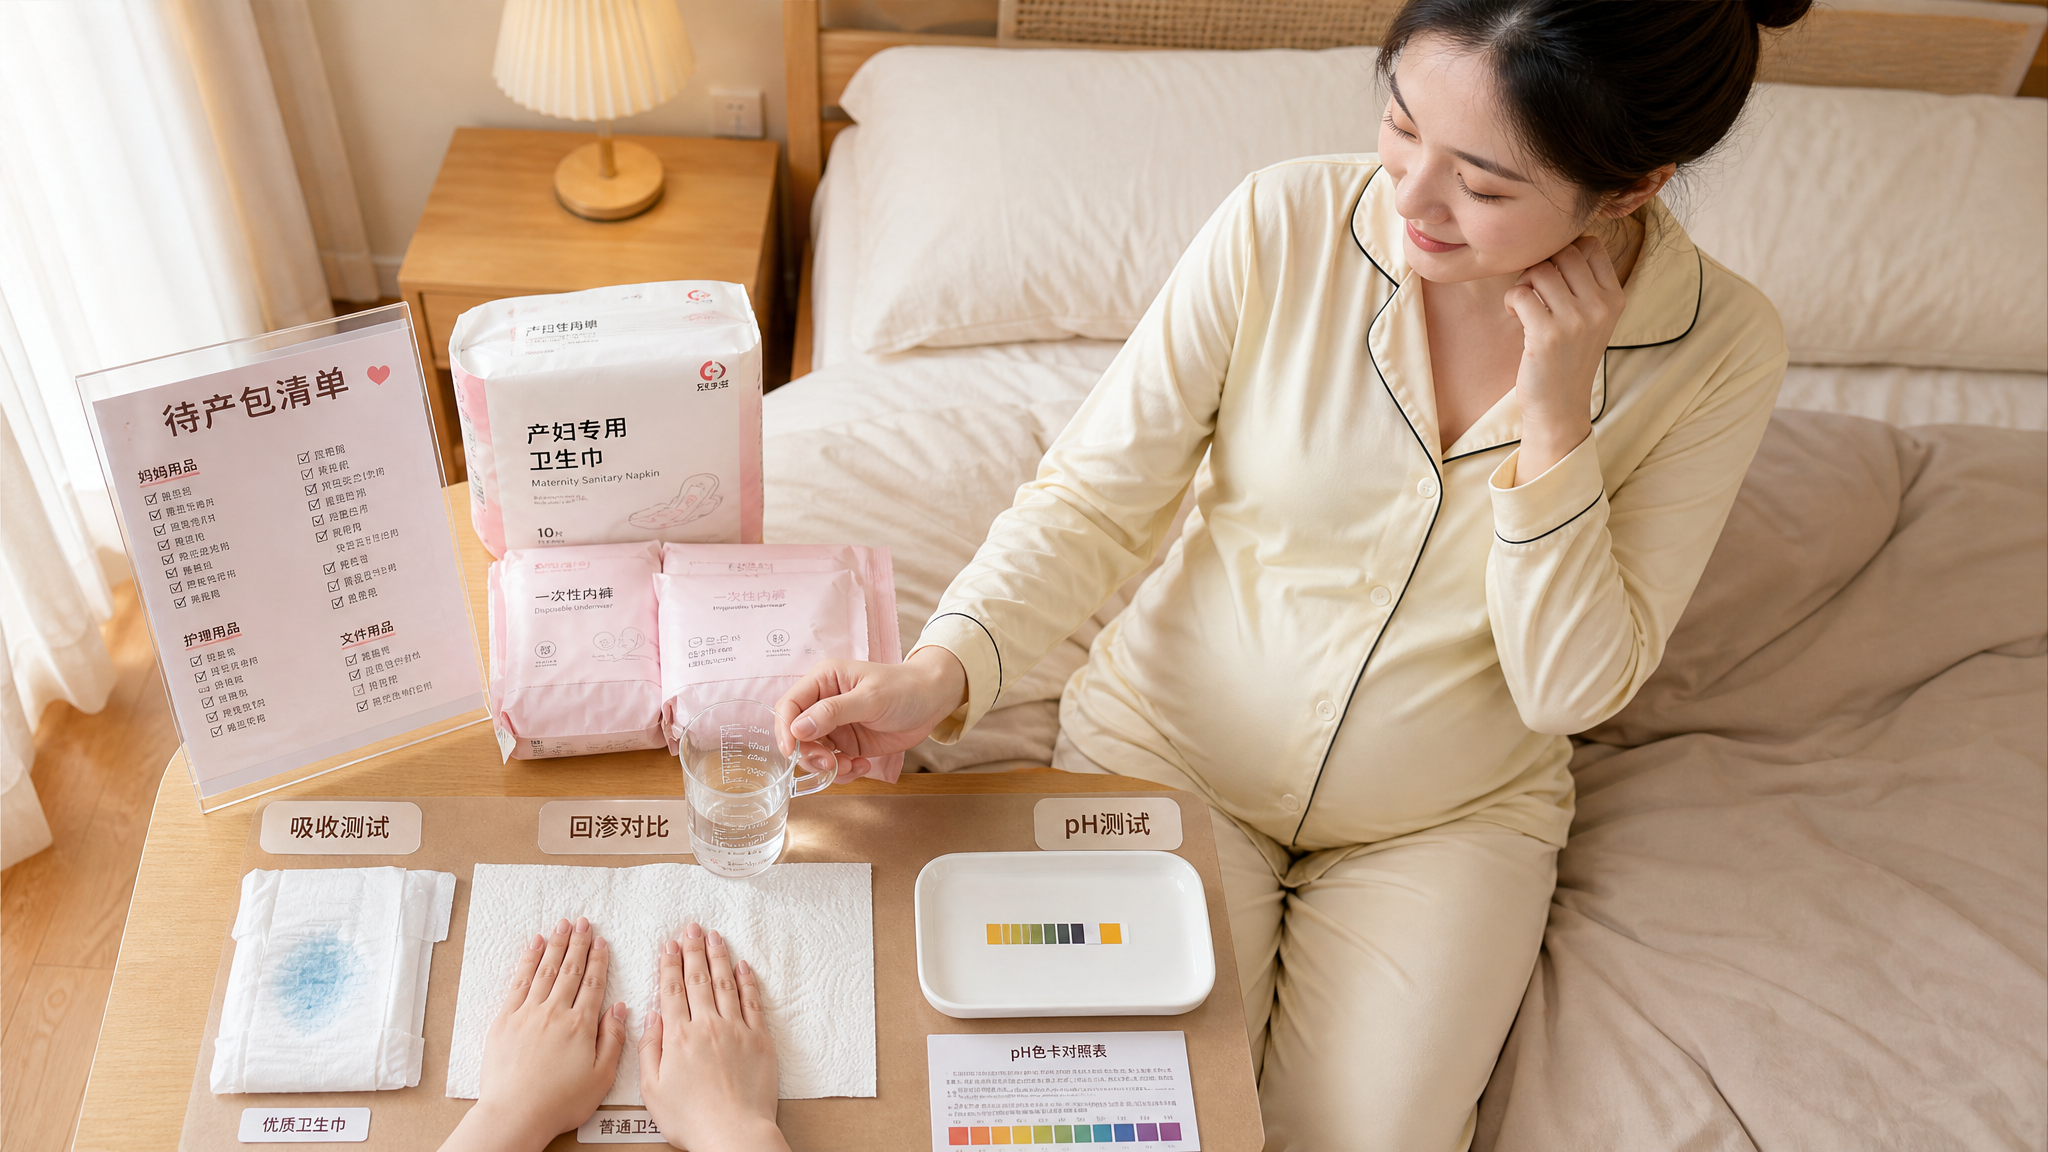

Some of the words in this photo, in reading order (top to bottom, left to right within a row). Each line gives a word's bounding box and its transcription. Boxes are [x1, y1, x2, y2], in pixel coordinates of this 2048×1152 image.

[162, 366, 349, 438] 待产包清单
[527, 417, 627, 445] 产妇专用
[137, 458, 199, 484] 妈妈用品
[529, 446, 603, 471] 卫生巾
[531, 477, 580, 488] Maternity
[581, 473, 623, 485] Sanitary
[625, 469, 660, 481] Napkin
[183, 621, 241, 648] 护理用品
[340, 620, 394, 647] 文件用品
[290, 815, 390, 839] 吸收测试
[570, 814, 670, 839] 回渗对比
[1065, 811, 1151, 840] pH测试
[1010, 1043, 1108, 1062] pH色卡对照表
[262, 1116, 347, 1133] 优质卫生巾
